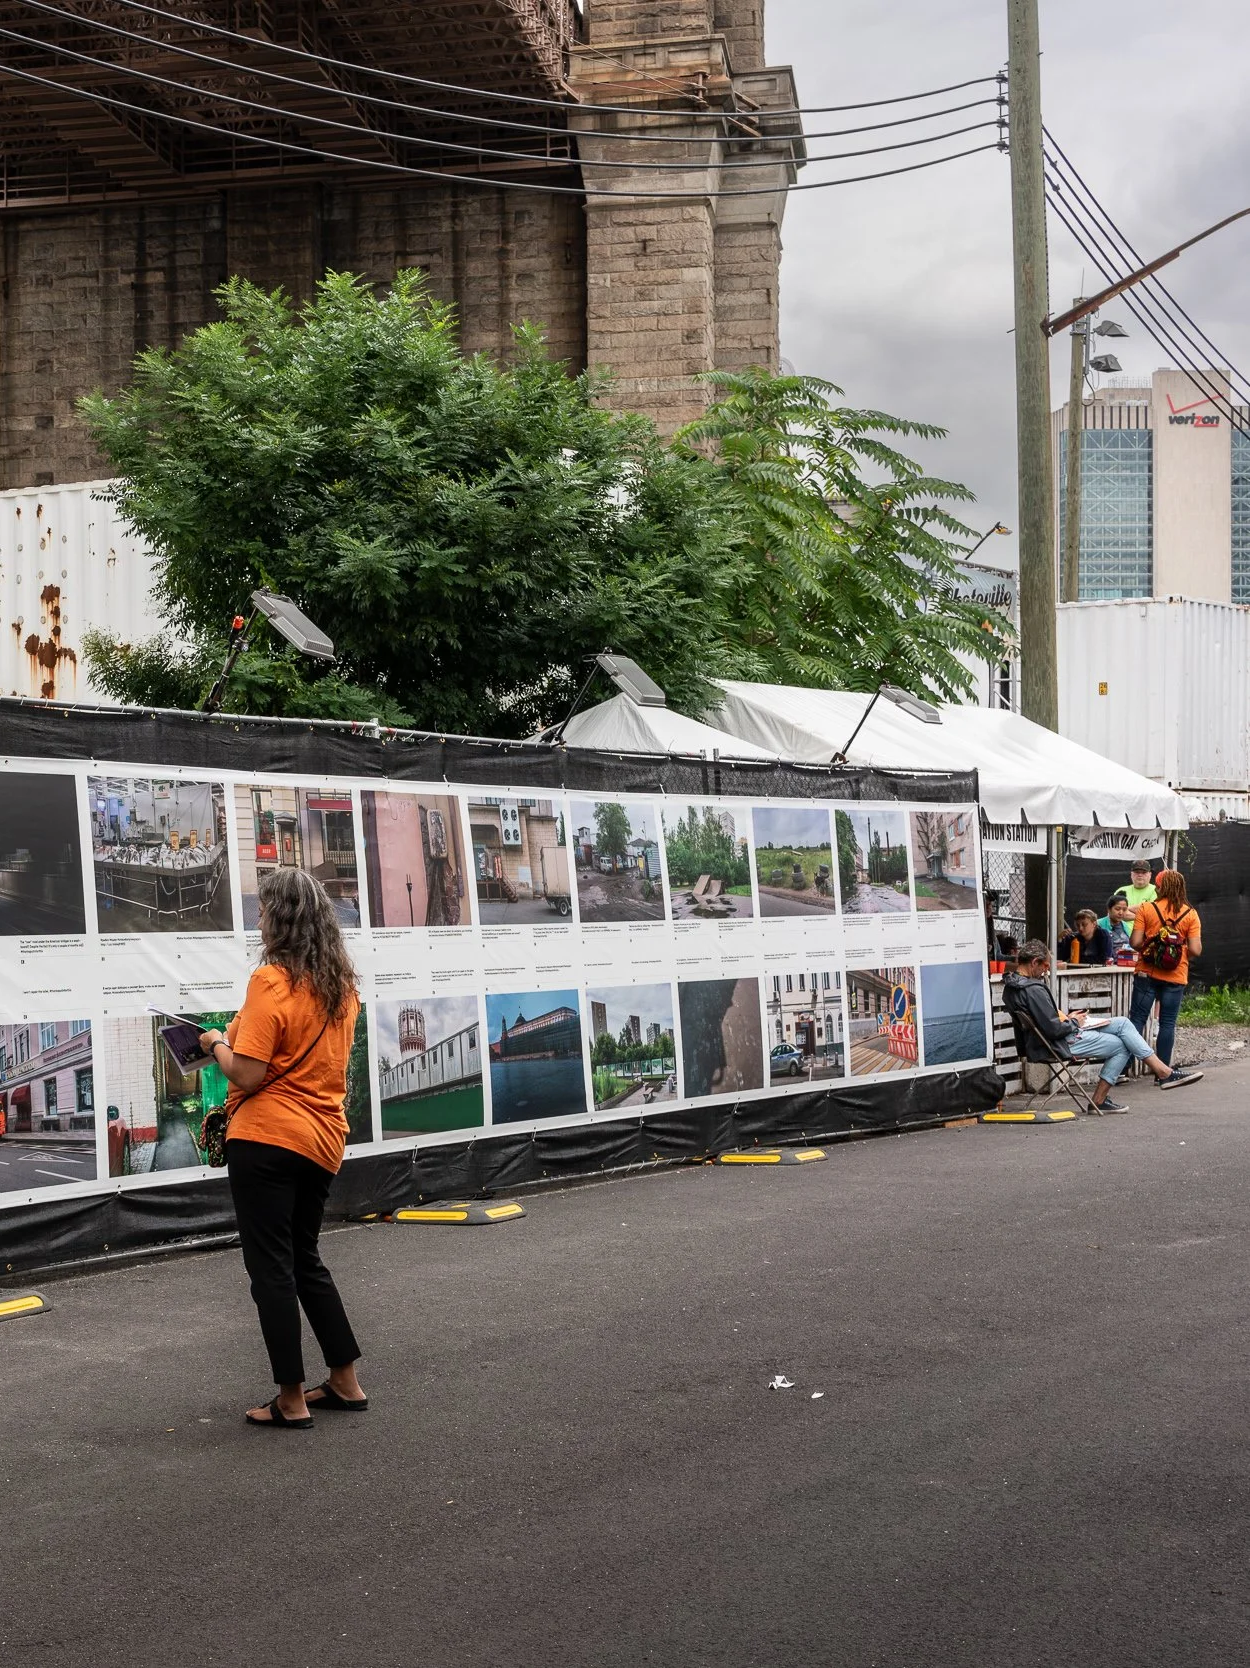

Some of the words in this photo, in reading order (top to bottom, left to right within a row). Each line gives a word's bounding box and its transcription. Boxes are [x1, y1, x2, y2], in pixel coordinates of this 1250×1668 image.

[1169, 413, 1220, 426] verizon
[953, 584, 1012, 607] hotoville
[1007, 824, 1038, 842] STATION
[1121, 833, 1139, 850] DAY
